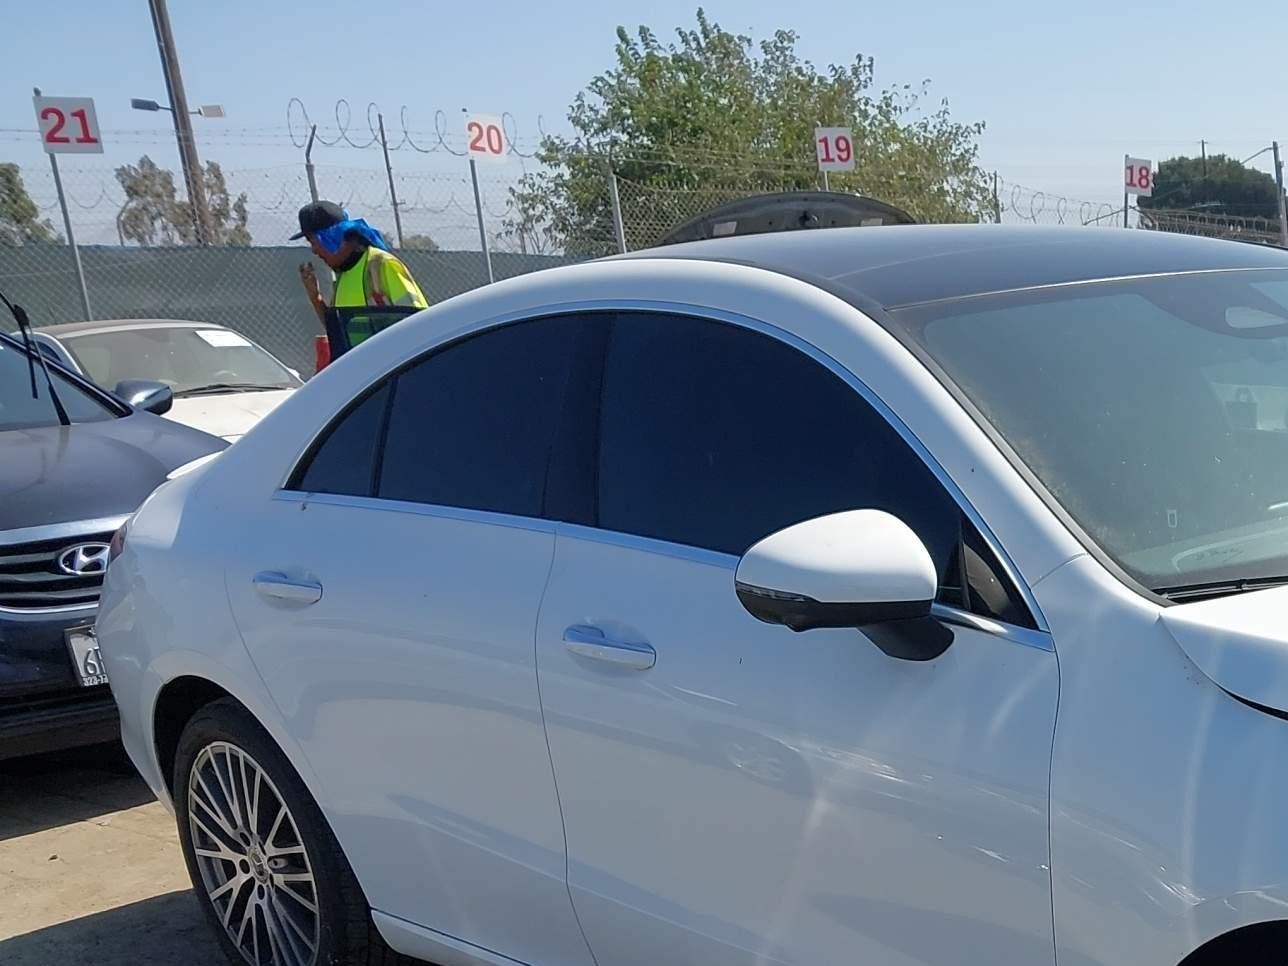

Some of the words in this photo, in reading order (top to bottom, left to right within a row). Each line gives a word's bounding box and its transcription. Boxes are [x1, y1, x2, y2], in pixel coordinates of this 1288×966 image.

[41, 107, 97, 144] 21
[467, 121, 503, 155] 20
[818, 136, 852, 163] 19
[1125, 164, 1150, 190] 18
